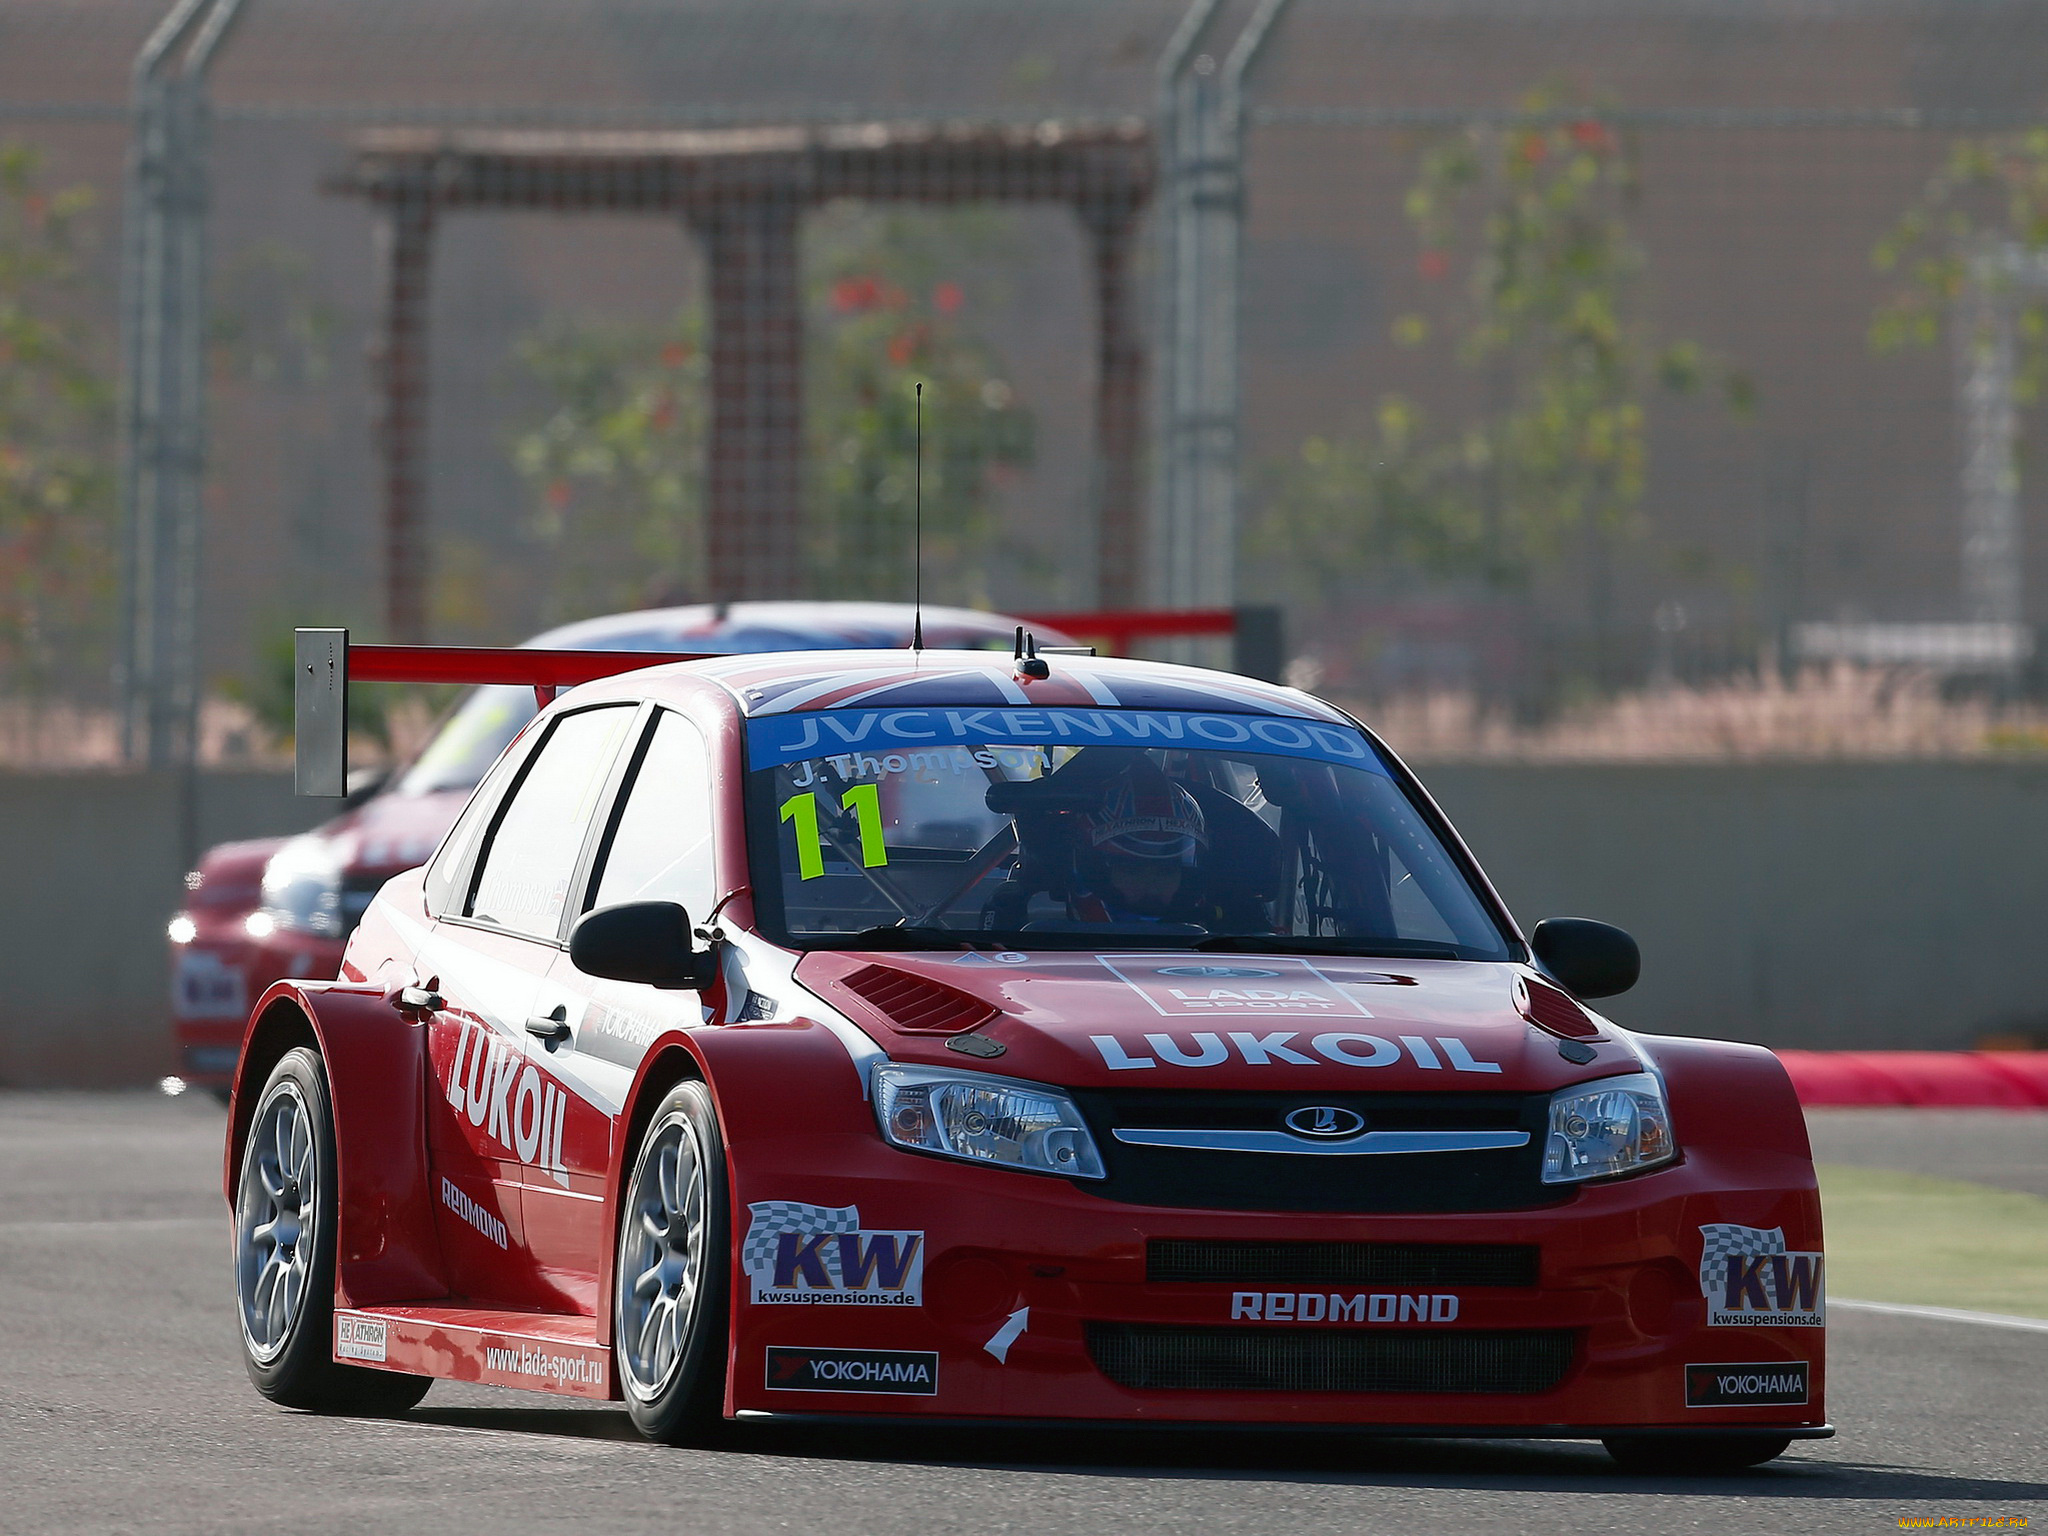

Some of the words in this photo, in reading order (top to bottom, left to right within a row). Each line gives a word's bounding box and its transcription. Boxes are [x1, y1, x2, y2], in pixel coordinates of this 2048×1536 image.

[779, 783, 889, 882] 11
[1168, 989, 1331, 1001] LADA
[1183, 1001, 1336, 1009] SPORT
[1089, 1032, 1503, 1074] LUKOIL
[447, 1013, 571, 1190] LUKOIL
[773, 1233, 922, 1290] KW
[1724, 1255, 1824, 1312] KW
[758, 1290, 915, 1305] kwsuspensions.de
[341, 1318, 384, 1344] HEXATHRON
[1713, 1312, 1822, 1327] kwsuspensions.de
[486, 1344, 603, 1387] www.lada-sport.ru
[810, 1360, 930, 1383] YOKOHAMA
[1717, 1374, 1804, 1394] YOKOHAMA
